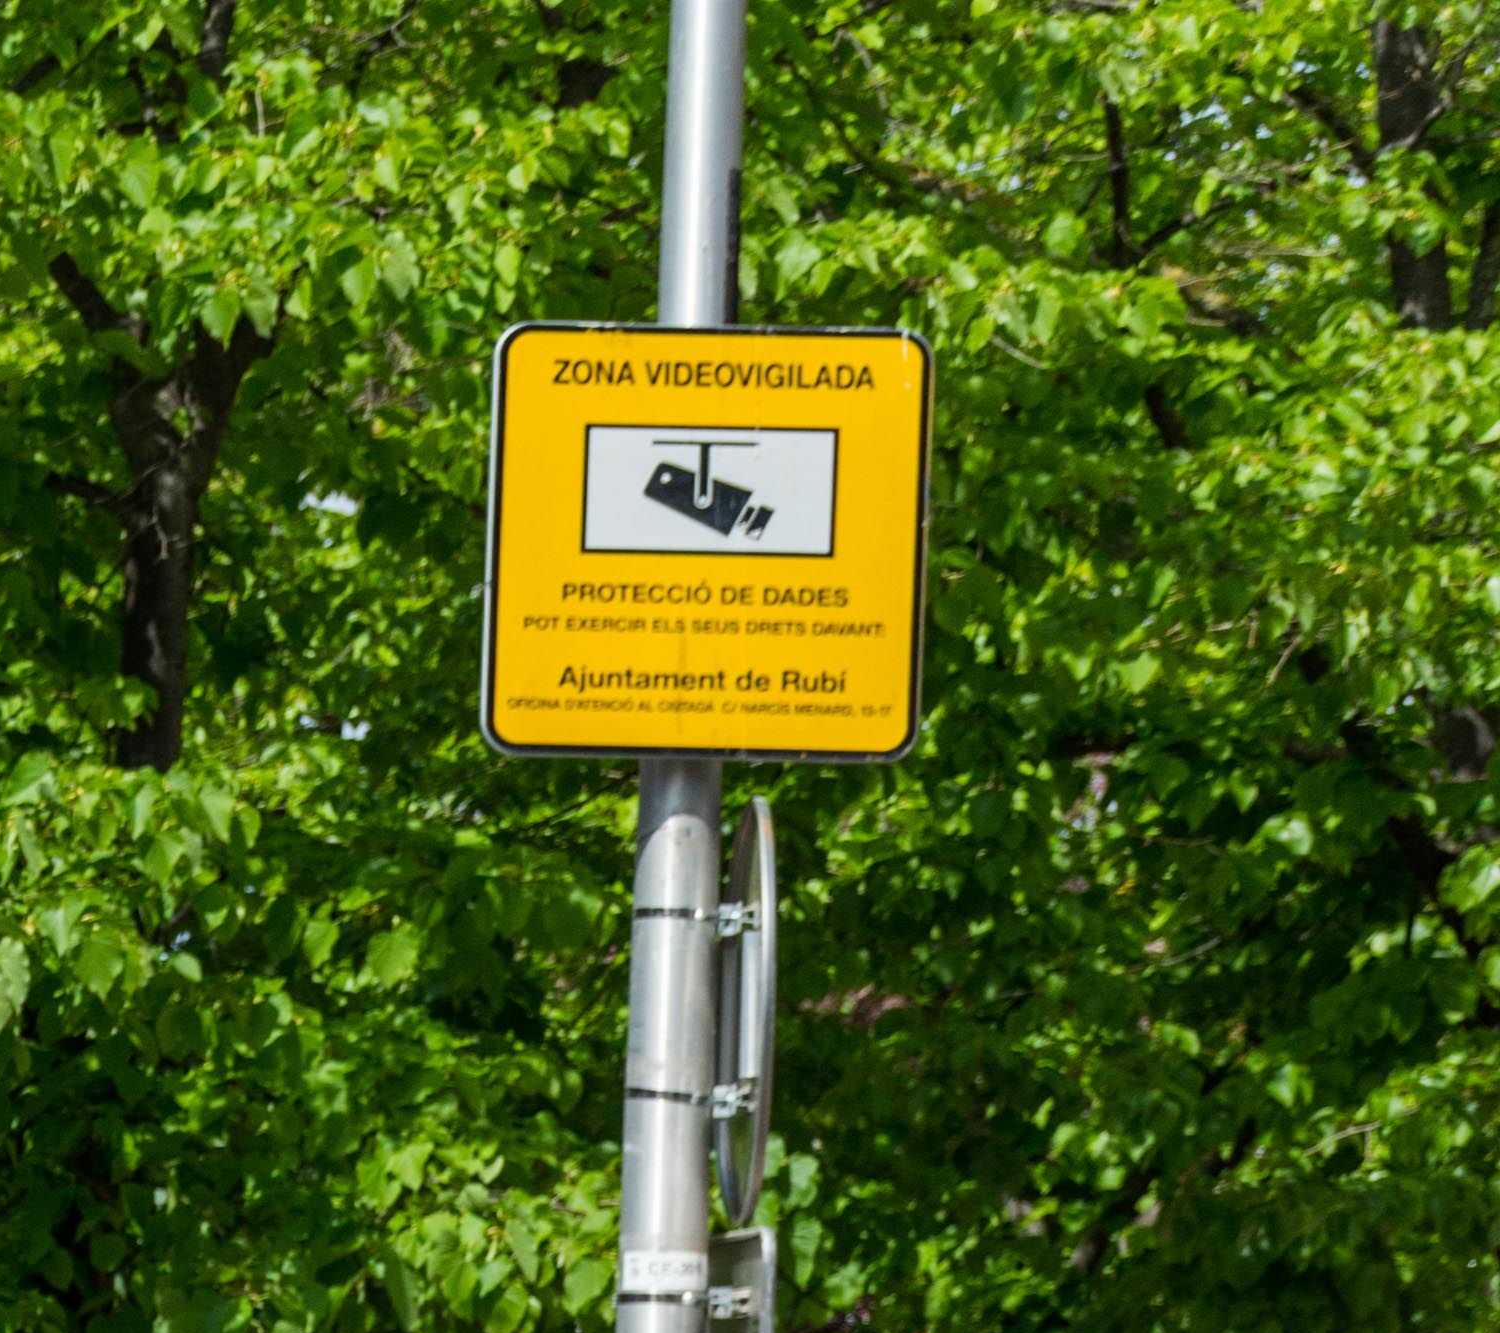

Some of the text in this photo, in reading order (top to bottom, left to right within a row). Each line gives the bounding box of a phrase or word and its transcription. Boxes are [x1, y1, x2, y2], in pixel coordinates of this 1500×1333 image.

[553, 360, 876, 391] ZONA VIDEOVIGILADA
[561, 579, 849, 608] PROTECCIÓ DE DADES
[523, 616, 559, 631] POT
[566, 617, 646, 633] EXERCIR
[652, 619, 684, 634] ELS
[691, 619, 740, 635] SEUS
[746, 620, 806, 636] DRETS
[559, 666, 846, 695] Ajuntament de Rubí
